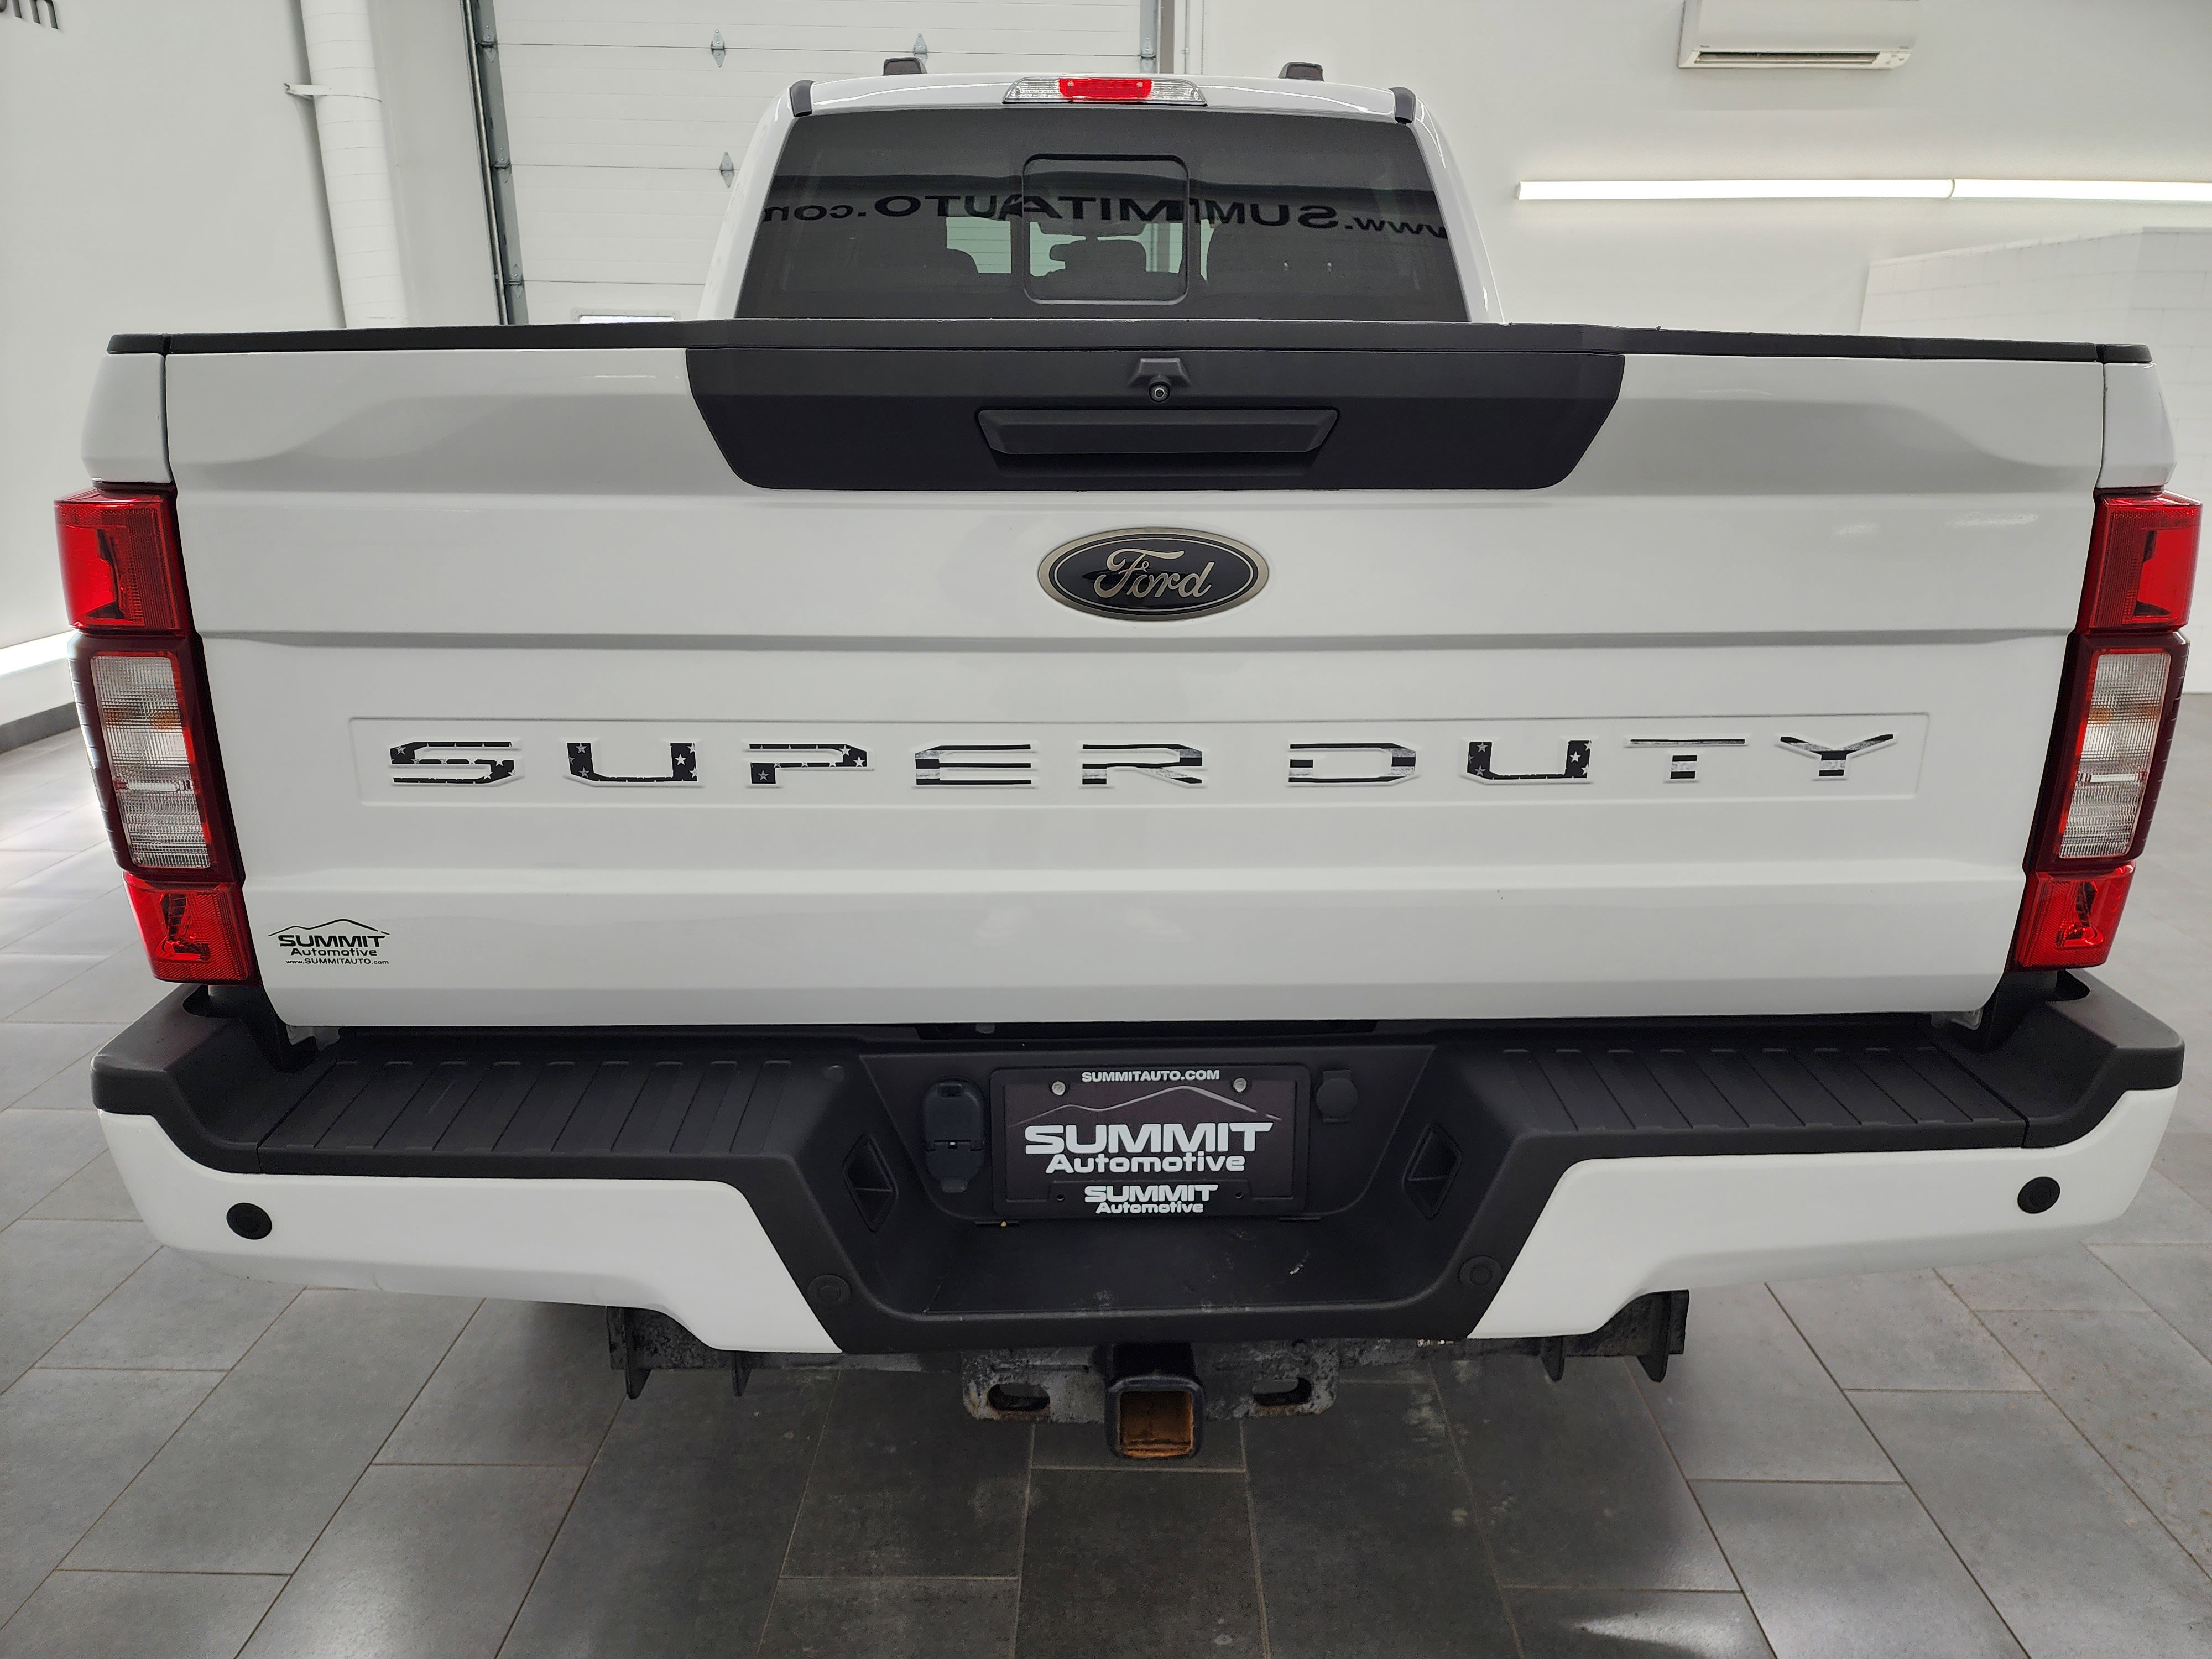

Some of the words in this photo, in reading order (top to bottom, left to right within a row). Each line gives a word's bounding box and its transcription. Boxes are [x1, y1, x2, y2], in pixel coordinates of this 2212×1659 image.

[1094, 547, 1215, 598] Ford
[389, 740, 1204, 786] SUPER
[1288, 733, 1895, 784] DUTY
[278, 935, 386, 947] SUMMIT
[290, 947, 378, 957] Automotive
[1082, 1070, 1220, 1082] SUMMITAUTO.COM
[1025, 1122, 1274, 1155] SUMMIT
[1045, 1151, 1245, 1174] Automotive
[1084, 1184, 1219, 1203] SUMMIT
[1095, 1201, 1204, 1214] Automotive
